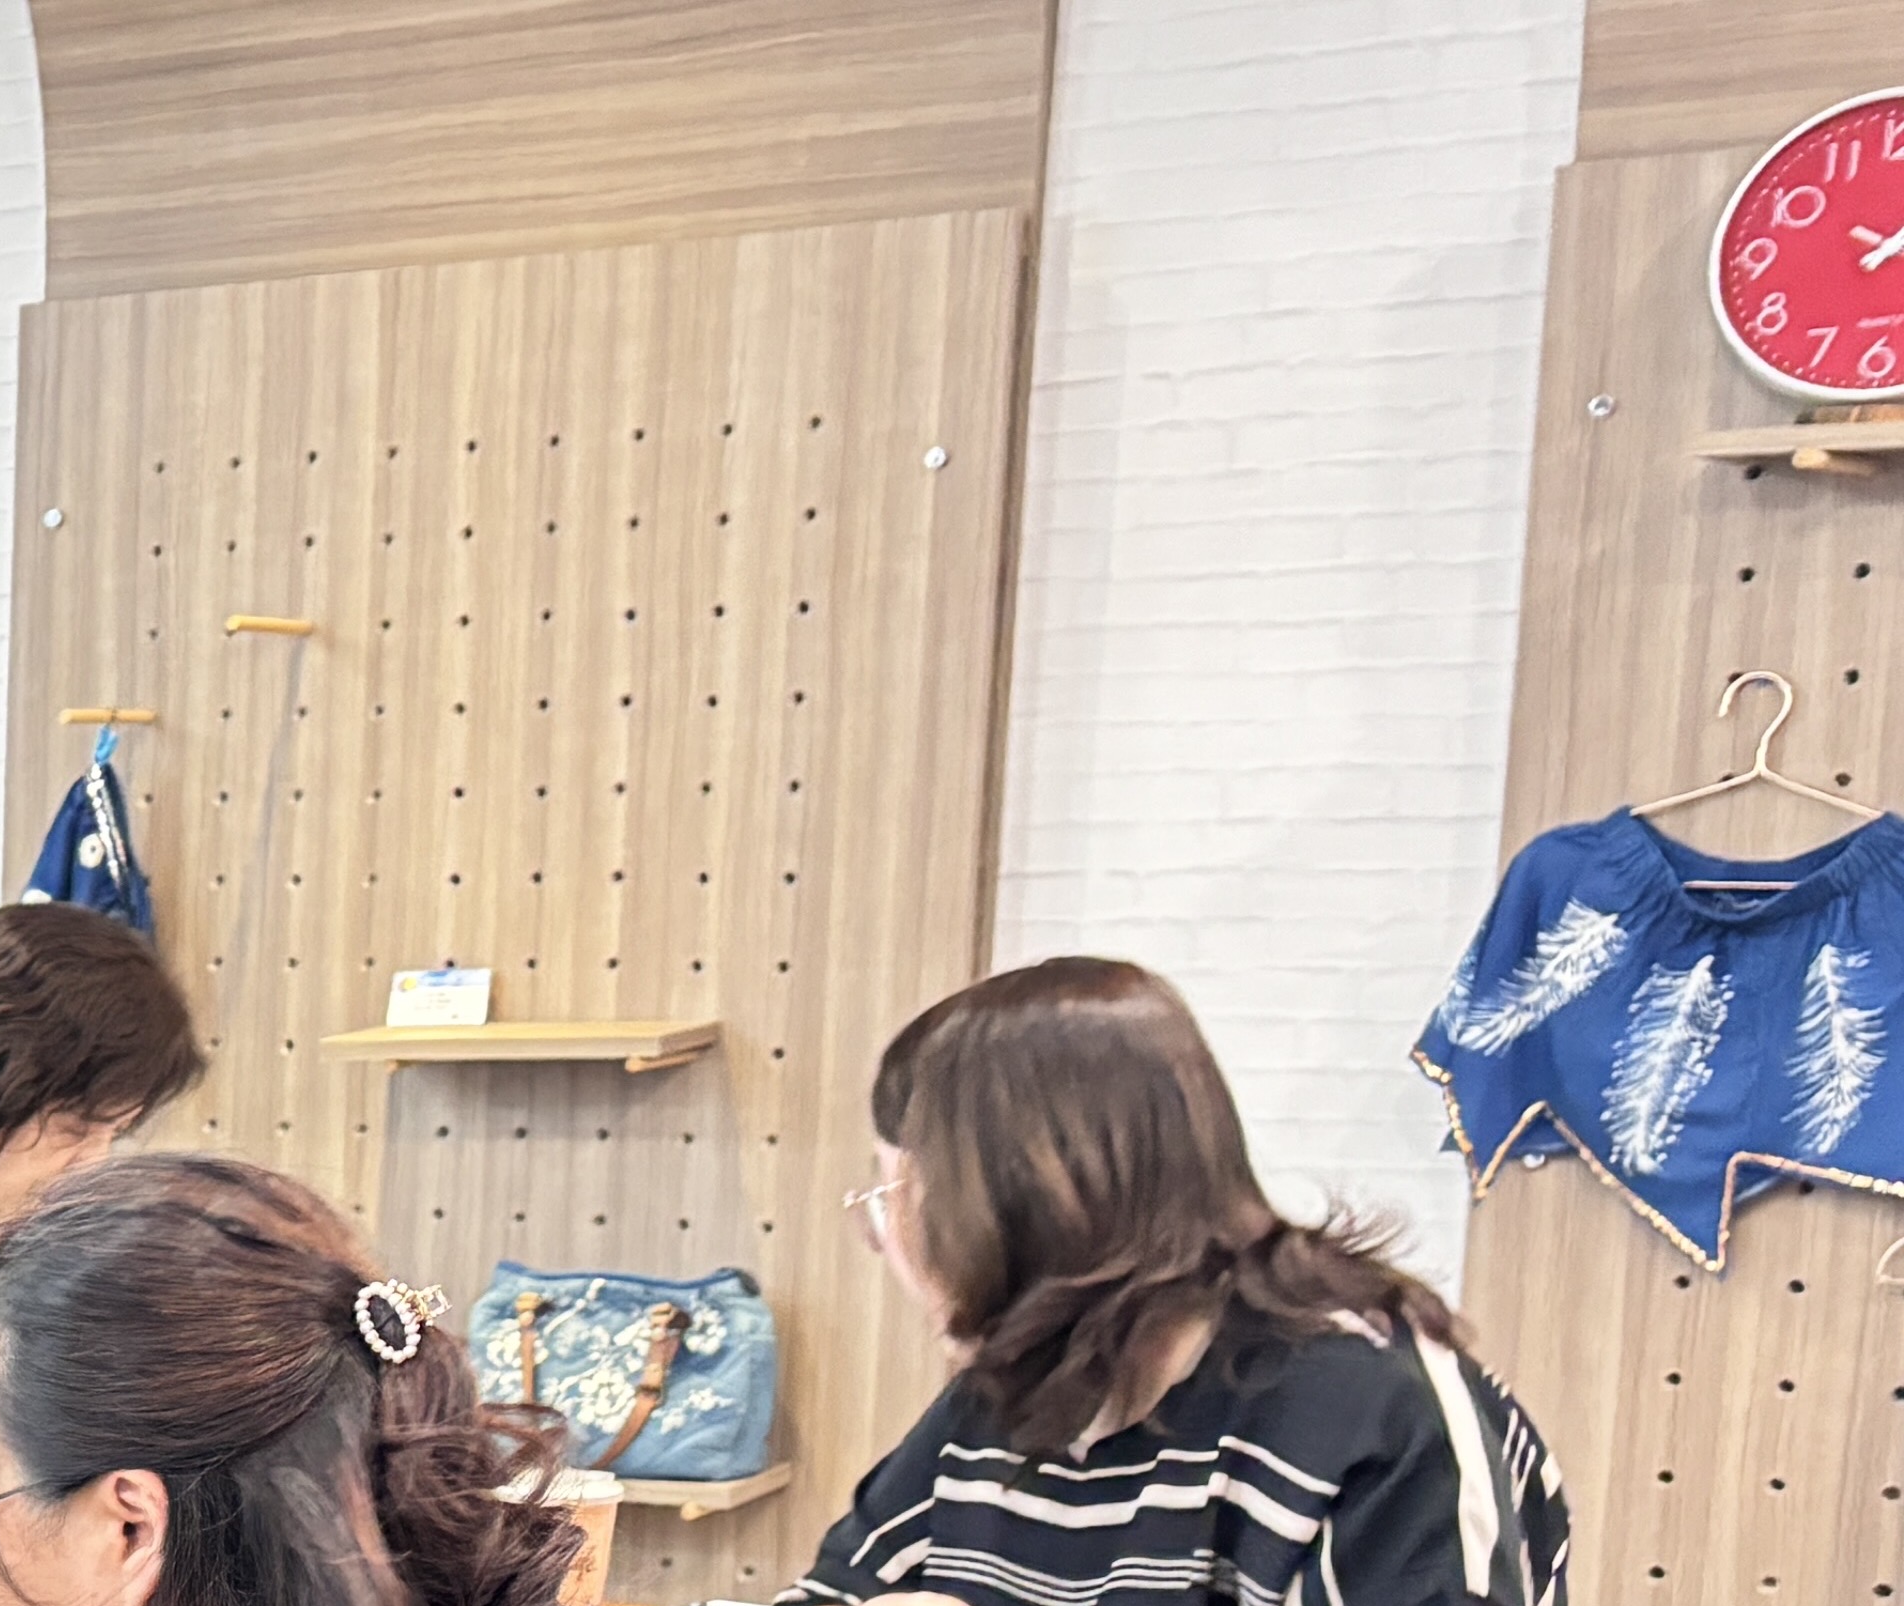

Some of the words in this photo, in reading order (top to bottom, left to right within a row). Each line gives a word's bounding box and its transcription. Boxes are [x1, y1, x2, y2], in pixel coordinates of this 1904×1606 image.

[1823, 140, 1862, 183] 11
[1770, 185, 1827, 229] 10
[1742, 237, 1779, 281] 9
[1756, 291, 1788, 336] 8
[1807, 325, 1840, 368] 7
[1857, 335, 1897, 379] 6
